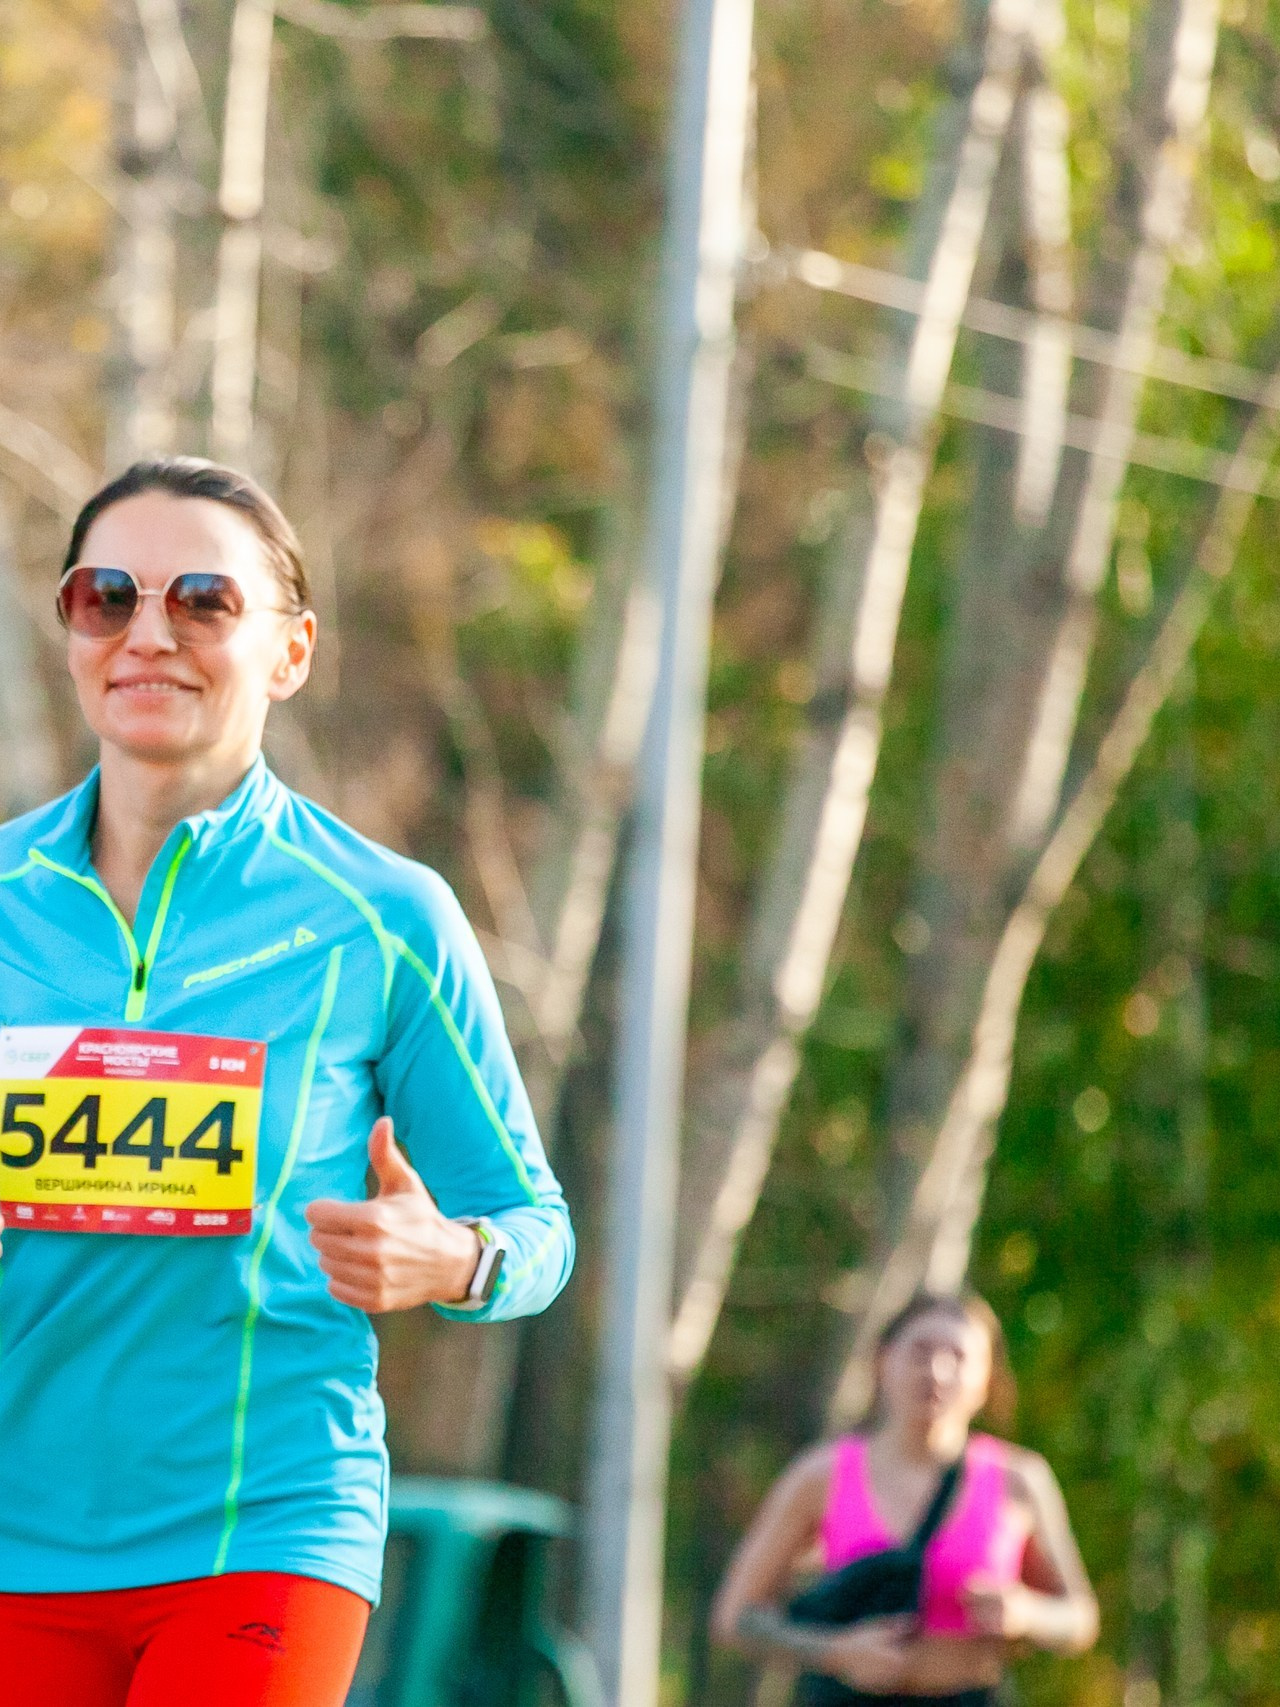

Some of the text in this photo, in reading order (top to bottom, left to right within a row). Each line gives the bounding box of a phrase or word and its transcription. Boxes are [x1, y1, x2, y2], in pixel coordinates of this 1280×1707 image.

[0, 1092, 244, 1176] 5444
[35, 1178, 197, 1196] ВЕРШИНИНА ИРИНА
